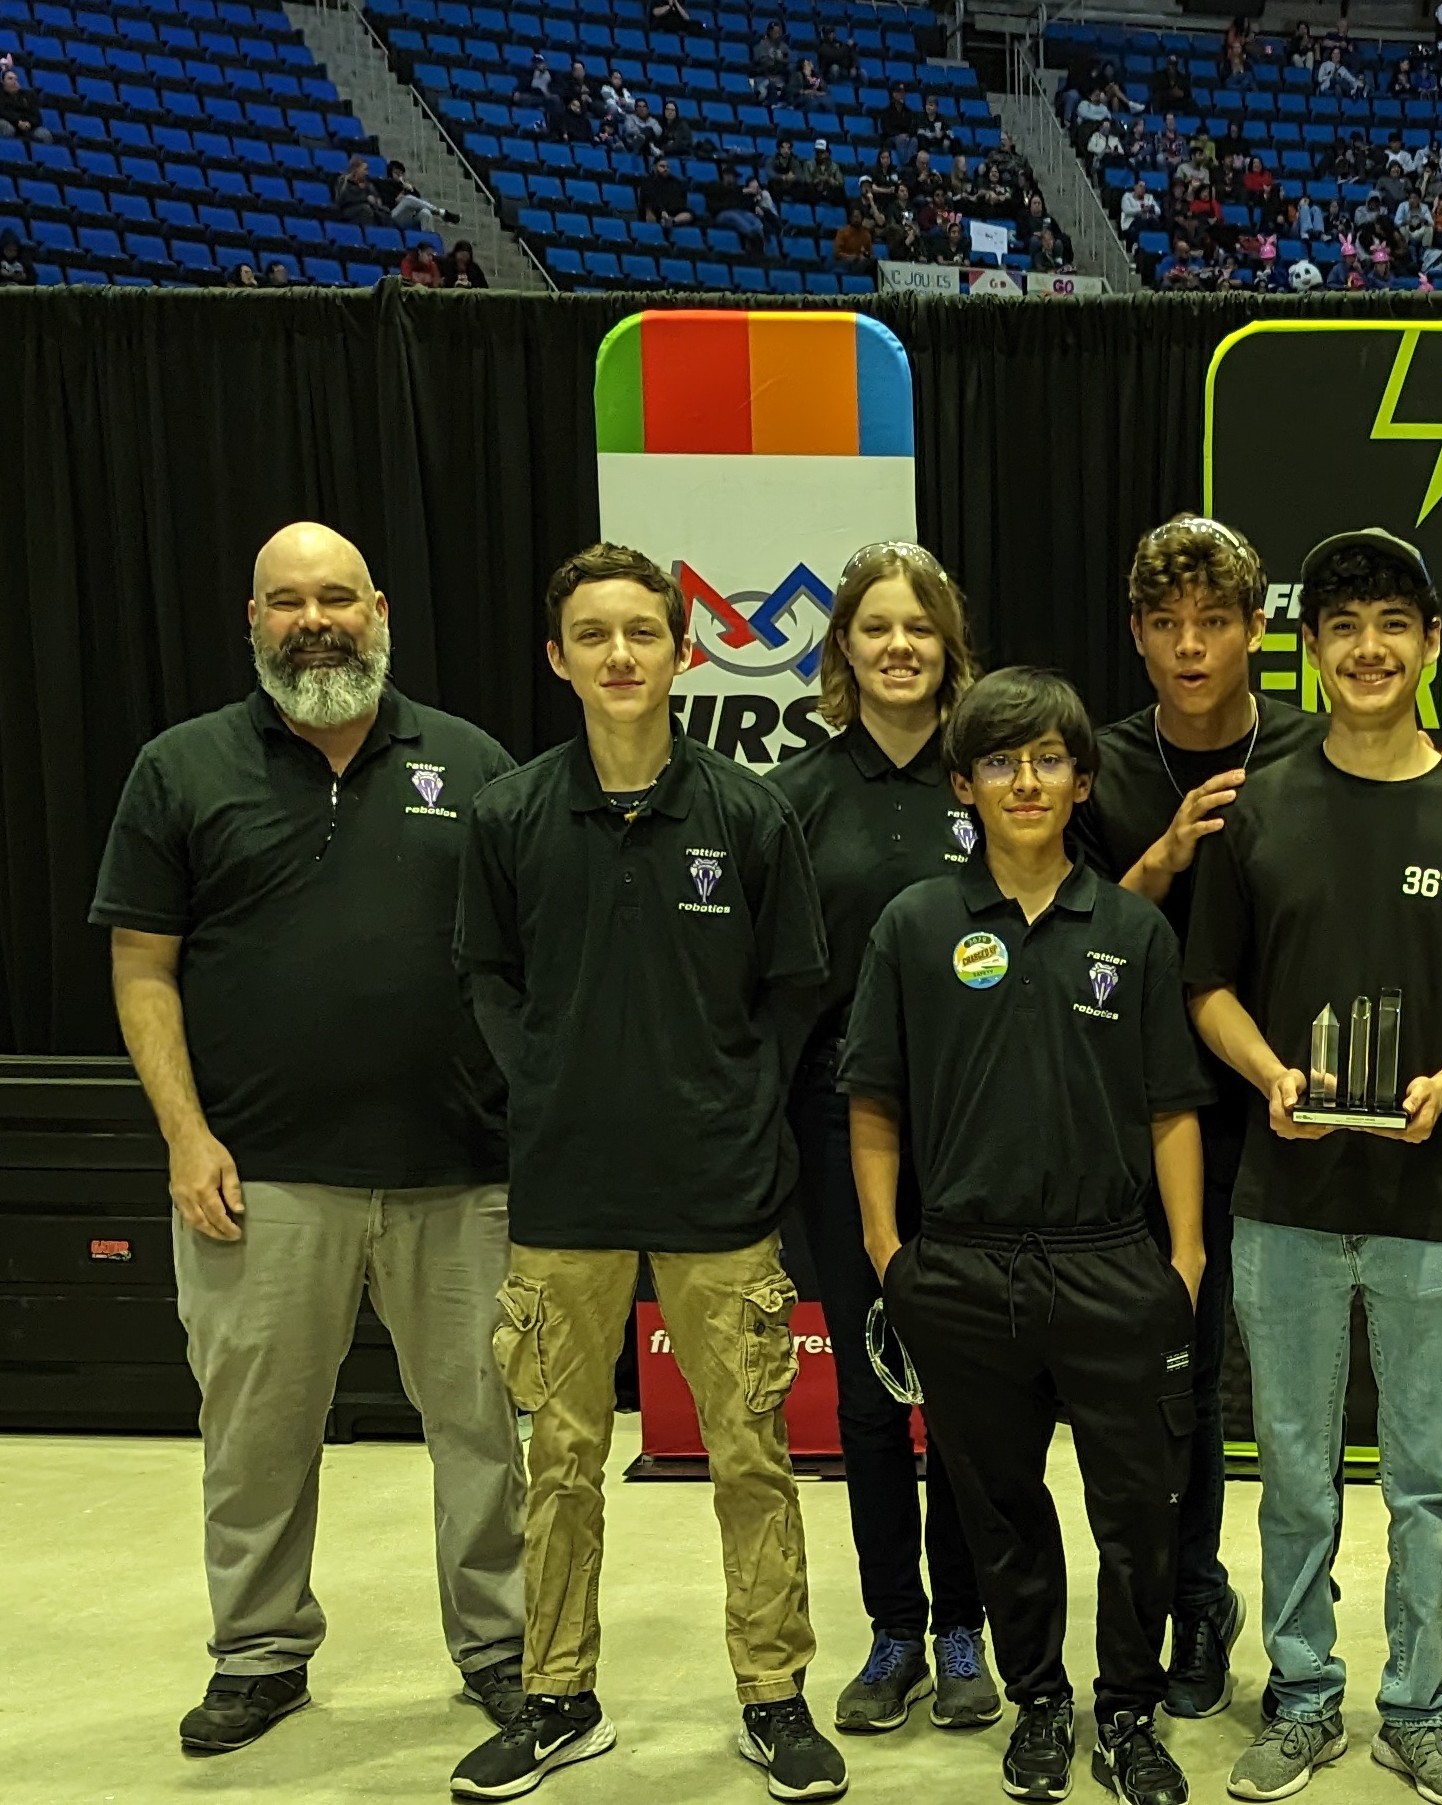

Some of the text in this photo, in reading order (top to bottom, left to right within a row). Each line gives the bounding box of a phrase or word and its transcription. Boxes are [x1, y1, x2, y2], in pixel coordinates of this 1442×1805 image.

[1052, 279, 1075, 295] GO
[405, 761, 446, 773] rattler
[405, 806, 457, 819] robotics
[947, 810, 970, 819] ratt
[685, 848, 727, 858] rattler
[678, 902, 731, 914] robotics
[1086, 950, 1127, 965] rattler
[1073, 1003, 1119, 1020] robotics
